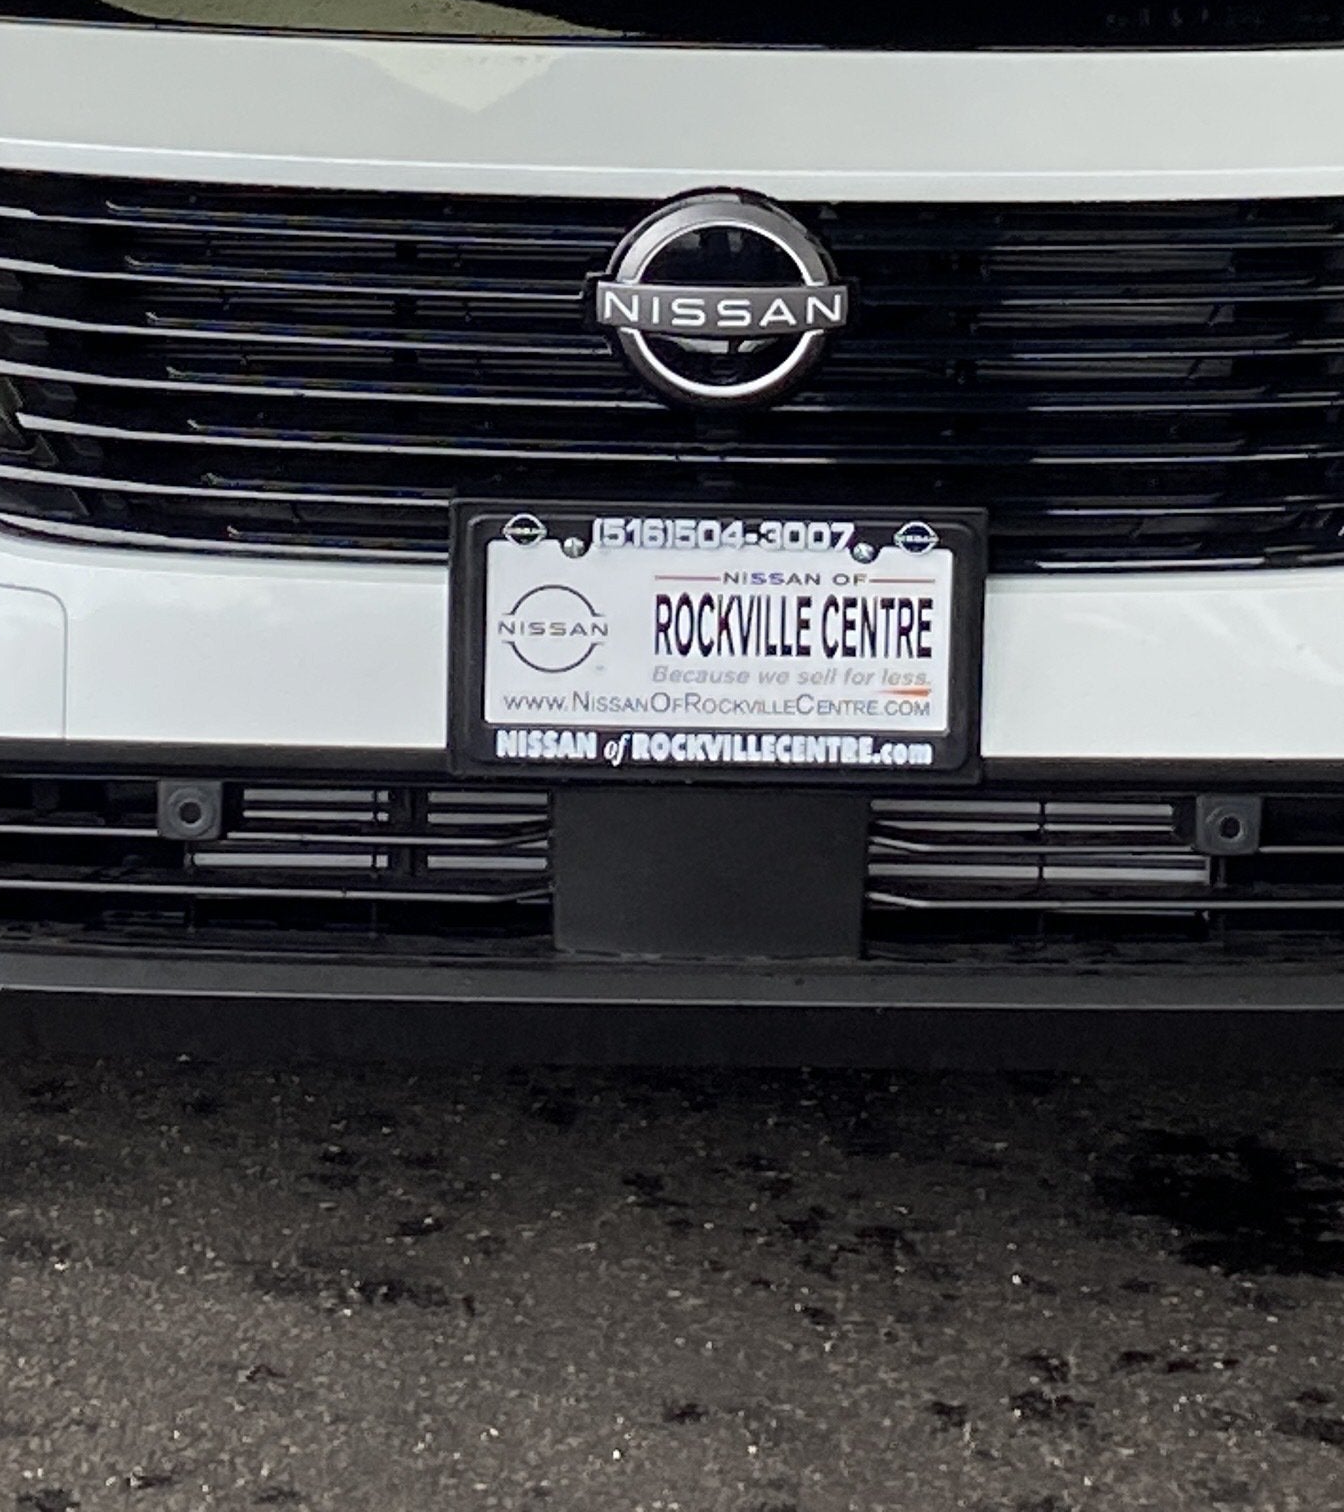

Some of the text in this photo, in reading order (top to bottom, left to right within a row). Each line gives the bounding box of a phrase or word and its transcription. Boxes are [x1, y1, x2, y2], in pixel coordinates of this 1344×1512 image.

[604, 290, 842, 327] NISSAN
[592, 516, 856, 553] (516)504-3007
[723, 571, 869, 587] NISSAN OF
[497, 619, 609, 638] NISSAN
[655, 591, 934, 659] ROCKVILLE CENTRE
[652, 664, 932, 687] Because we sell for less.
[495, 729, 934, 767] NISSAN of ROCKVILLECENTRE.com
